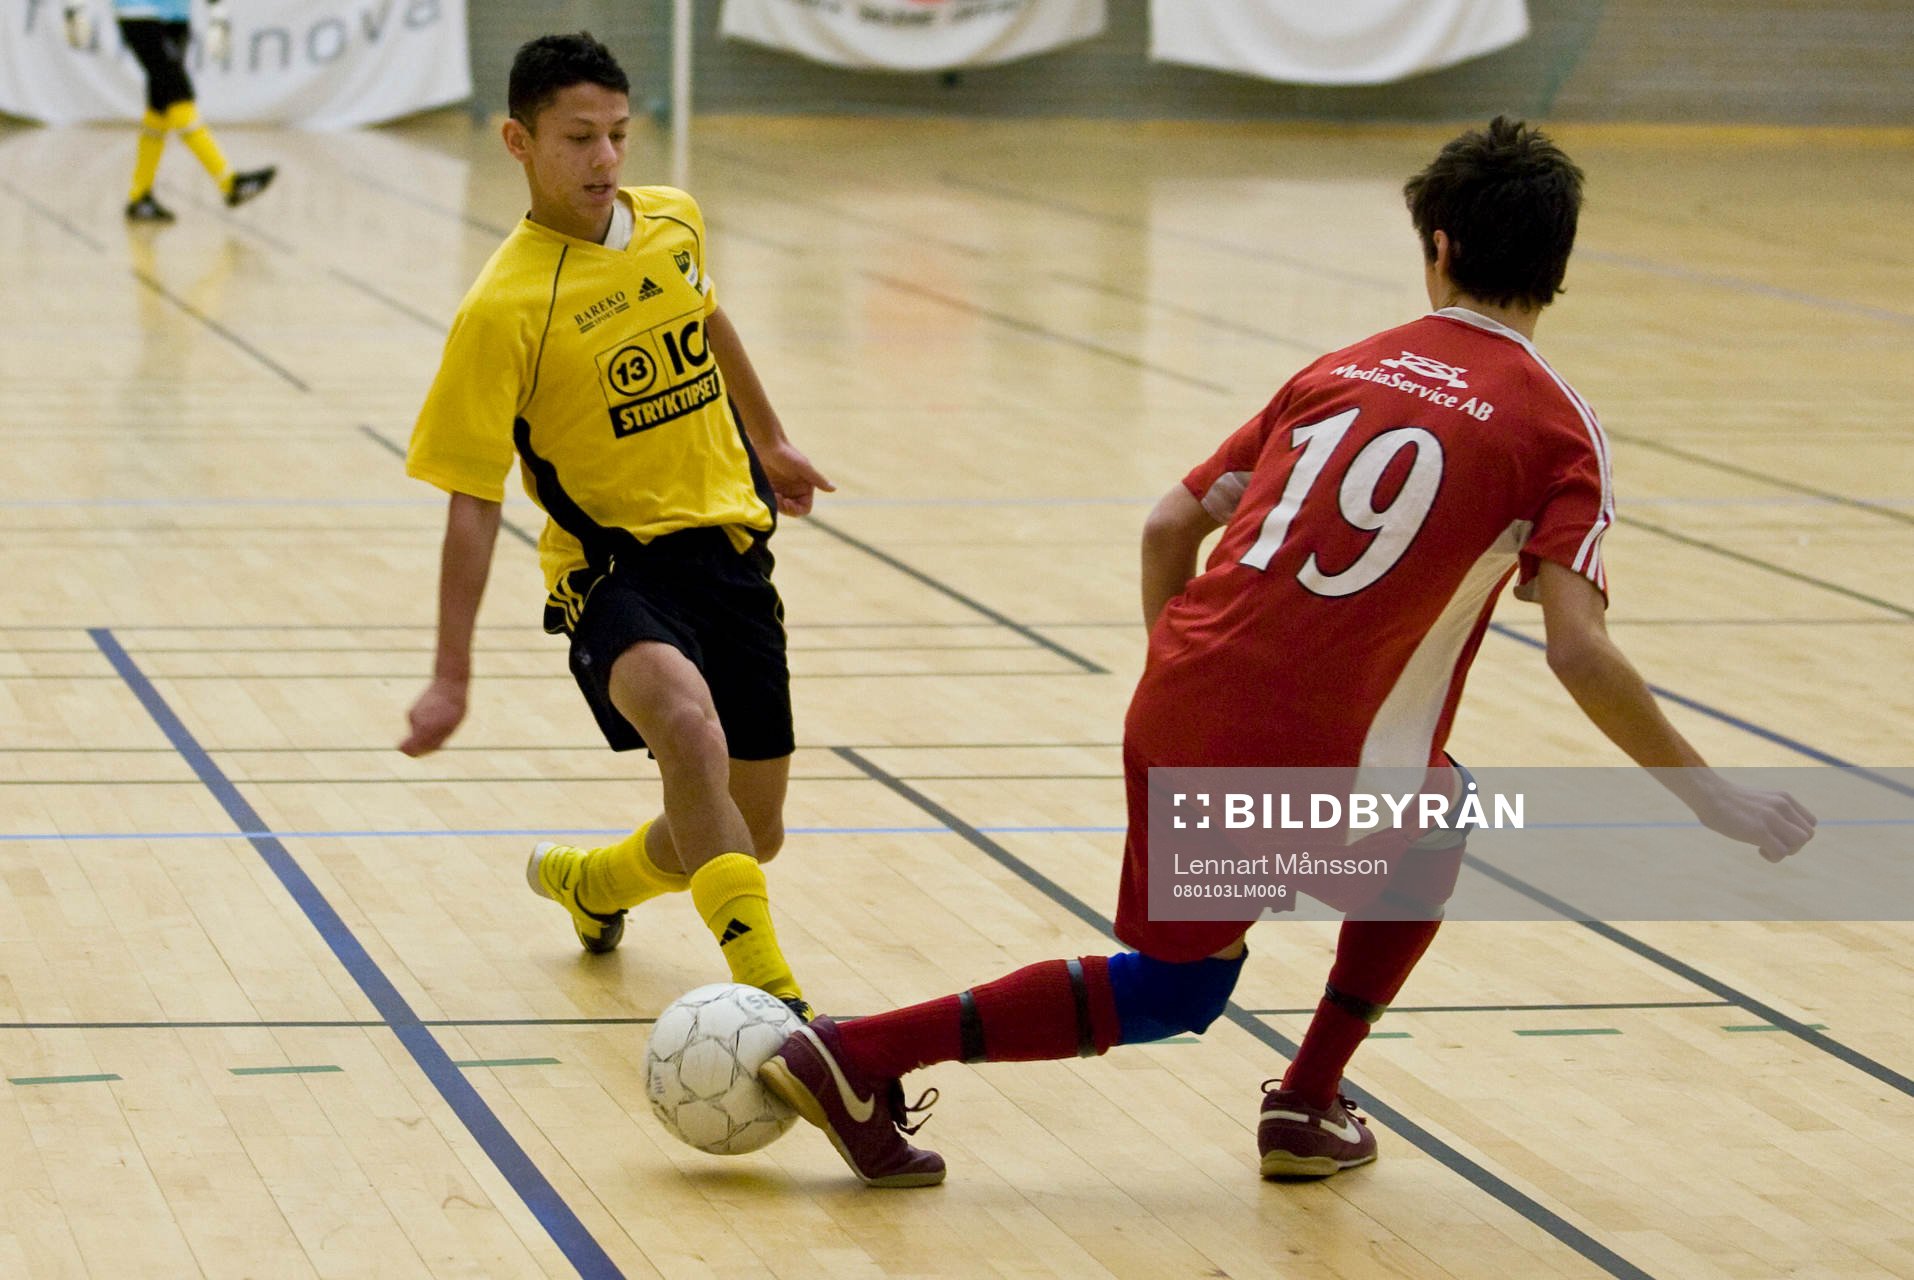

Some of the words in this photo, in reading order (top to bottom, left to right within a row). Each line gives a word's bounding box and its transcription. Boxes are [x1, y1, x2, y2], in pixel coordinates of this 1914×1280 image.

[574, 290, 626, 326] BAREKO
[638, 287, 664, 302] adidas
[616, 356, 648, 386] 13
[1330, 363, 1459, 409] MediaService
[1457, 396, 1495, 423] AB
[619, 373, 719, 431] STRYKTIPSET
[1239, 406, 1445, 598] 19
